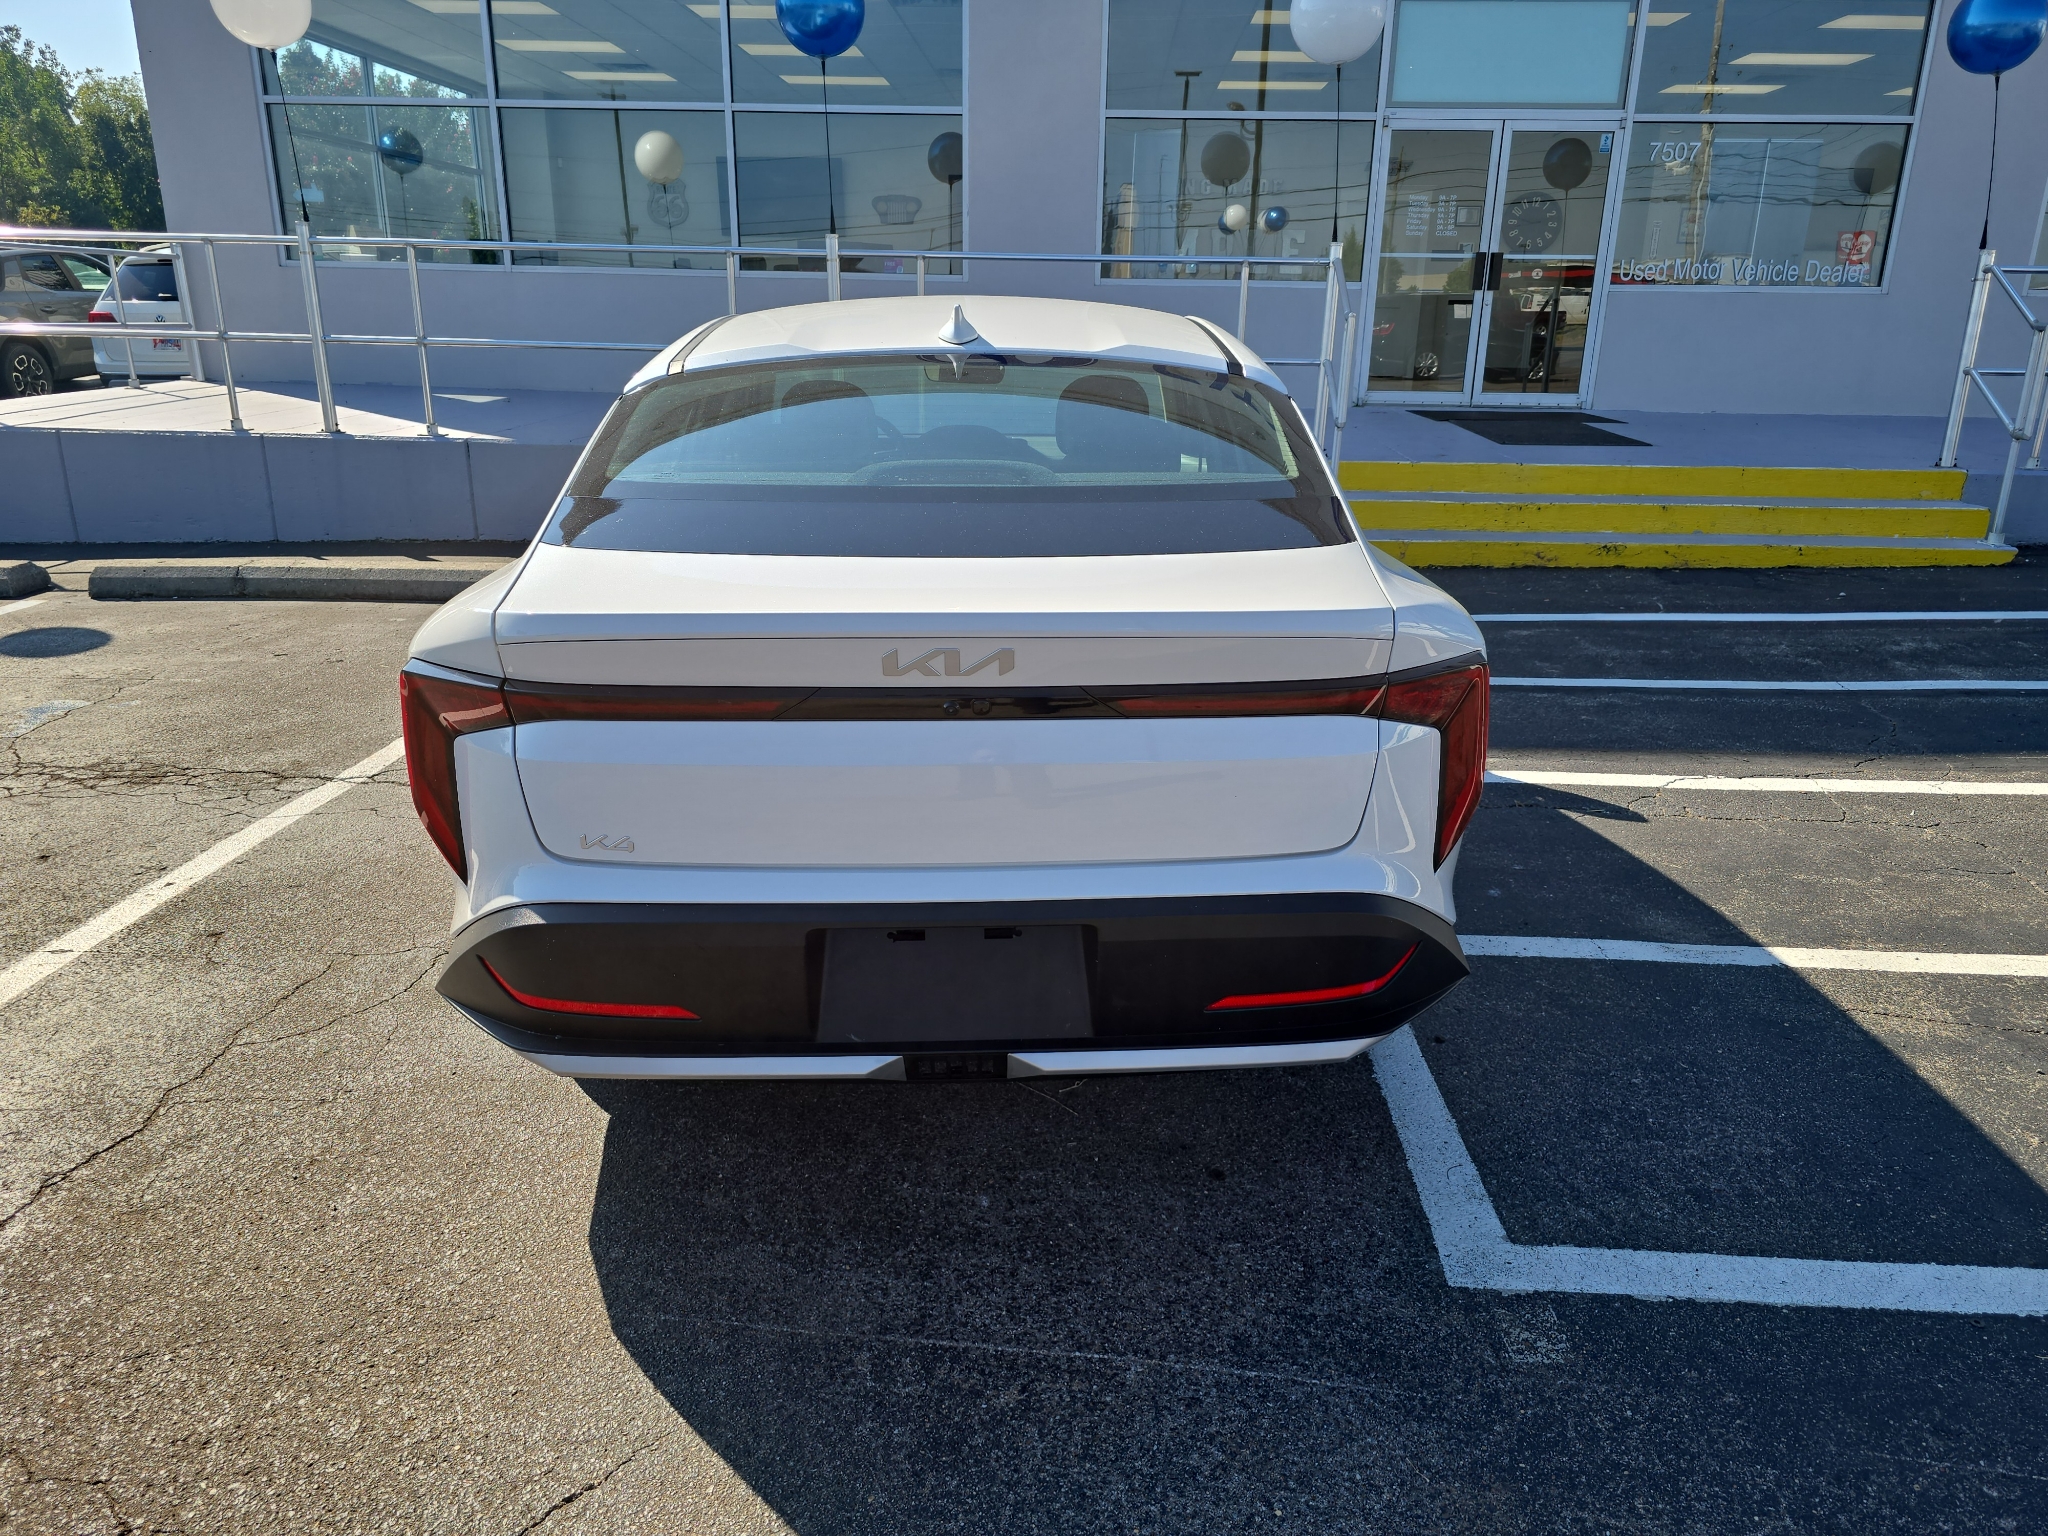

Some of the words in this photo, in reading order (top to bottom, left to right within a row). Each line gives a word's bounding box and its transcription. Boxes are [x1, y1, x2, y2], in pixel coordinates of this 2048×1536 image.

[1649, 142, 1702, 162] 7507
[652, 195, 683, 219] 66
[1522, 199, 1528, 209] 11
[1532, 197, 1541, 207] 12
[1543, 202, 1550, 210] 1
[1512, 206, 1522, 217] 10
[1547, 210, 1556, 218] 2
[1509, 229, 1518, 237] 8
[1544, 231, 1552, 239] 4
[1516, 236, 1523, 245] 7
[1526, 239, 1532, 249] 6
[1536, 237, 1543, 247] 5
[1620, 258, 1668, 281] Used
[1674, 258, 1727, 280] Motor
[1732, 259, 1799, 282] Vehicle
[1804, 259, 1866, 282] Dealer
[580, 834, 635, 853] K4
